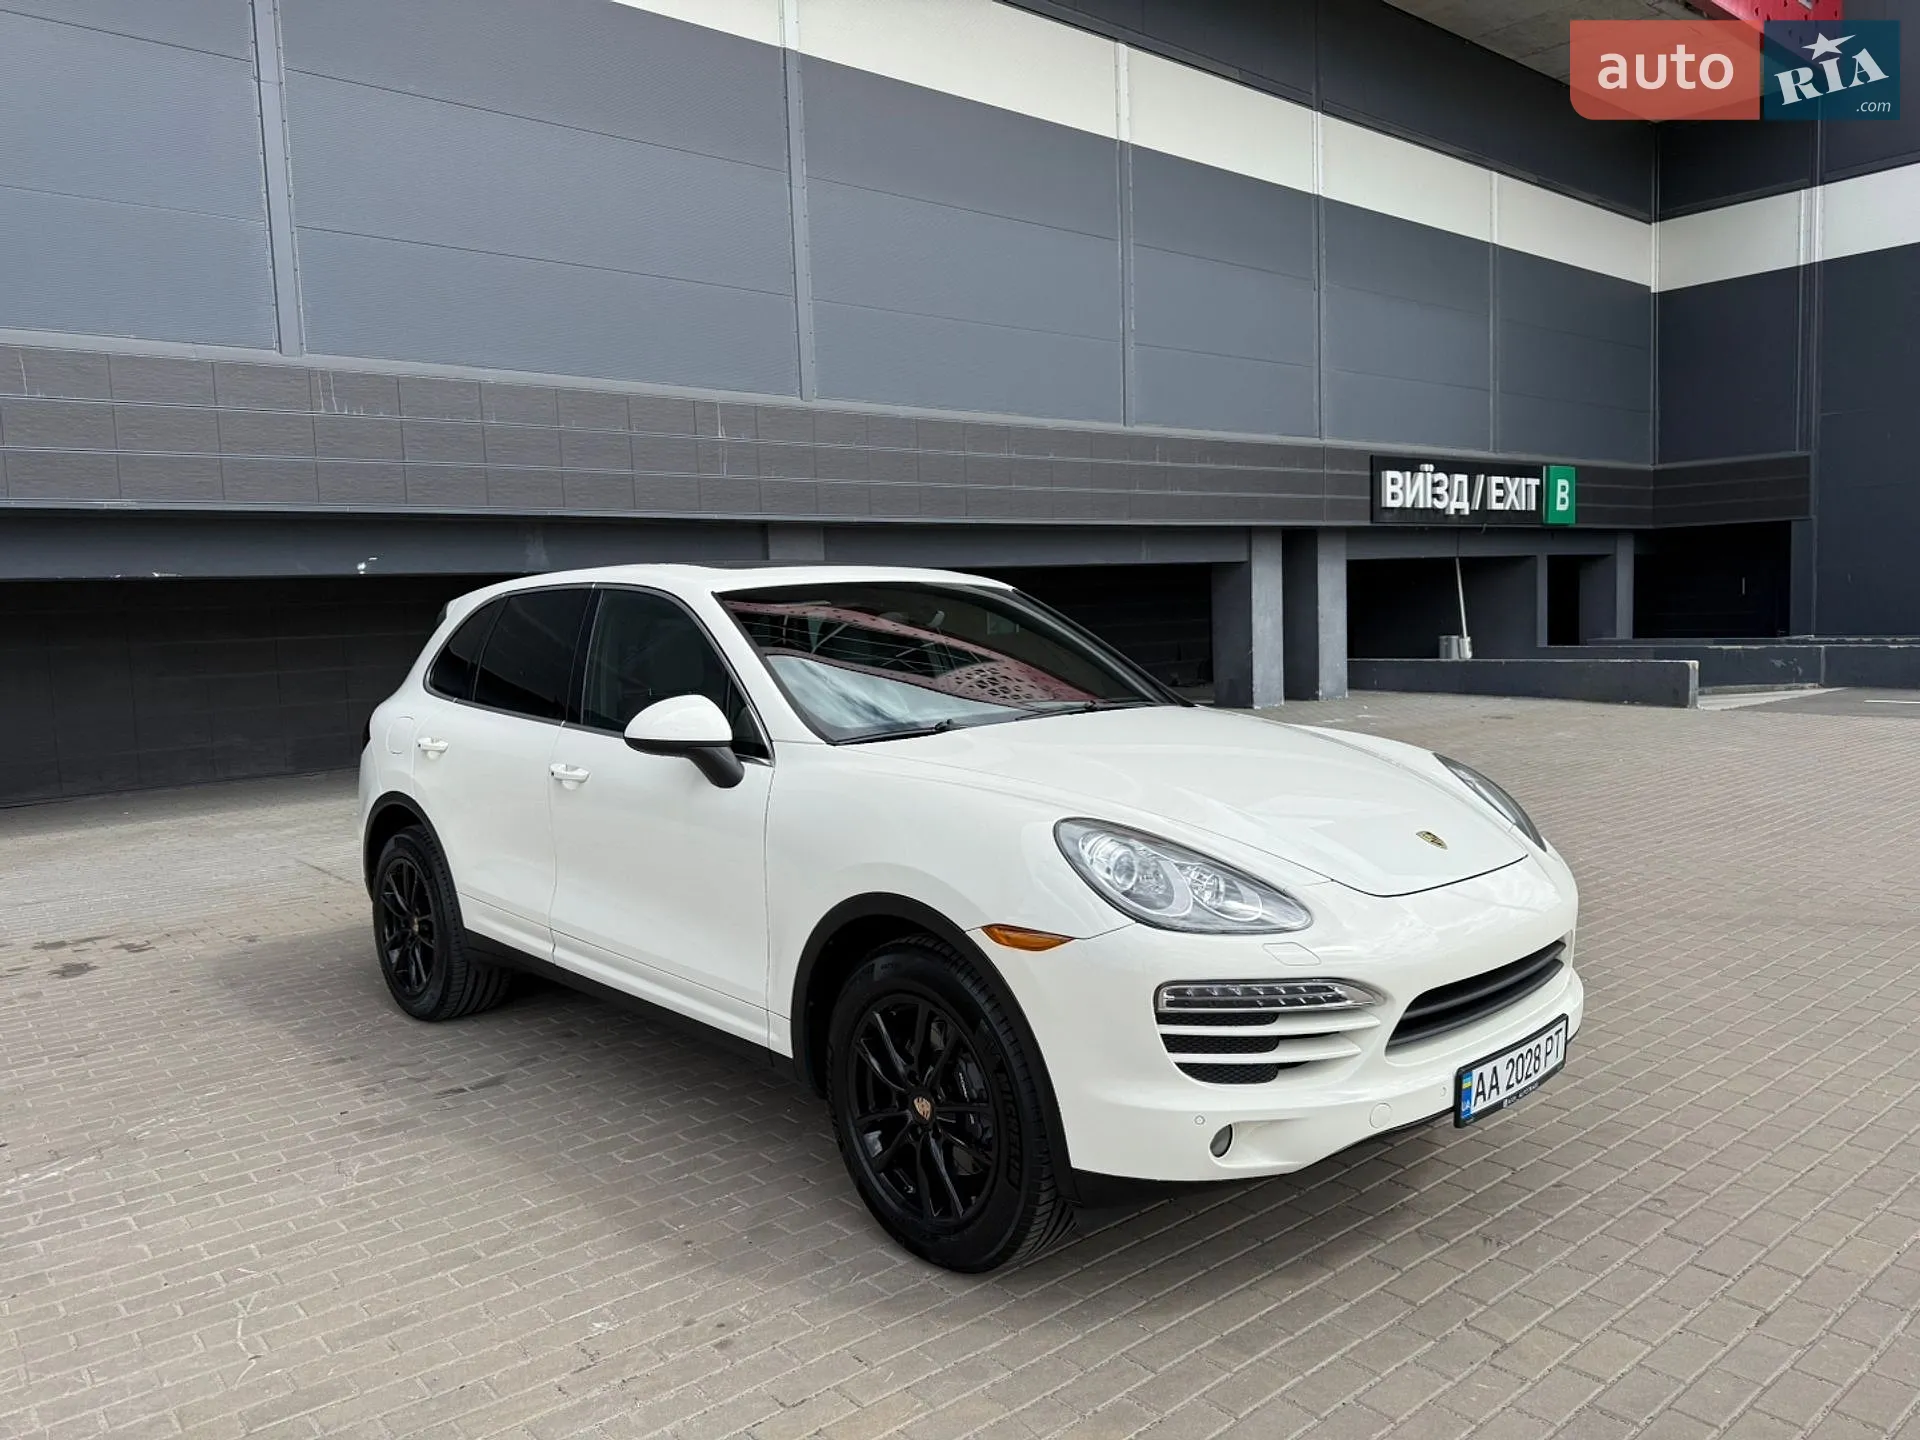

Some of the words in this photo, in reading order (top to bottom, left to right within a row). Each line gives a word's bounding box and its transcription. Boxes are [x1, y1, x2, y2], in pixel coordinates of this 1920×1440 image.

[1487, 475, 1540, 511] EXIT
[1473, 1066, 1499, 1107] AA
[1505, 1043, 1541, 1091] 2028
[1544, 1027, 1562, 1068] PT
